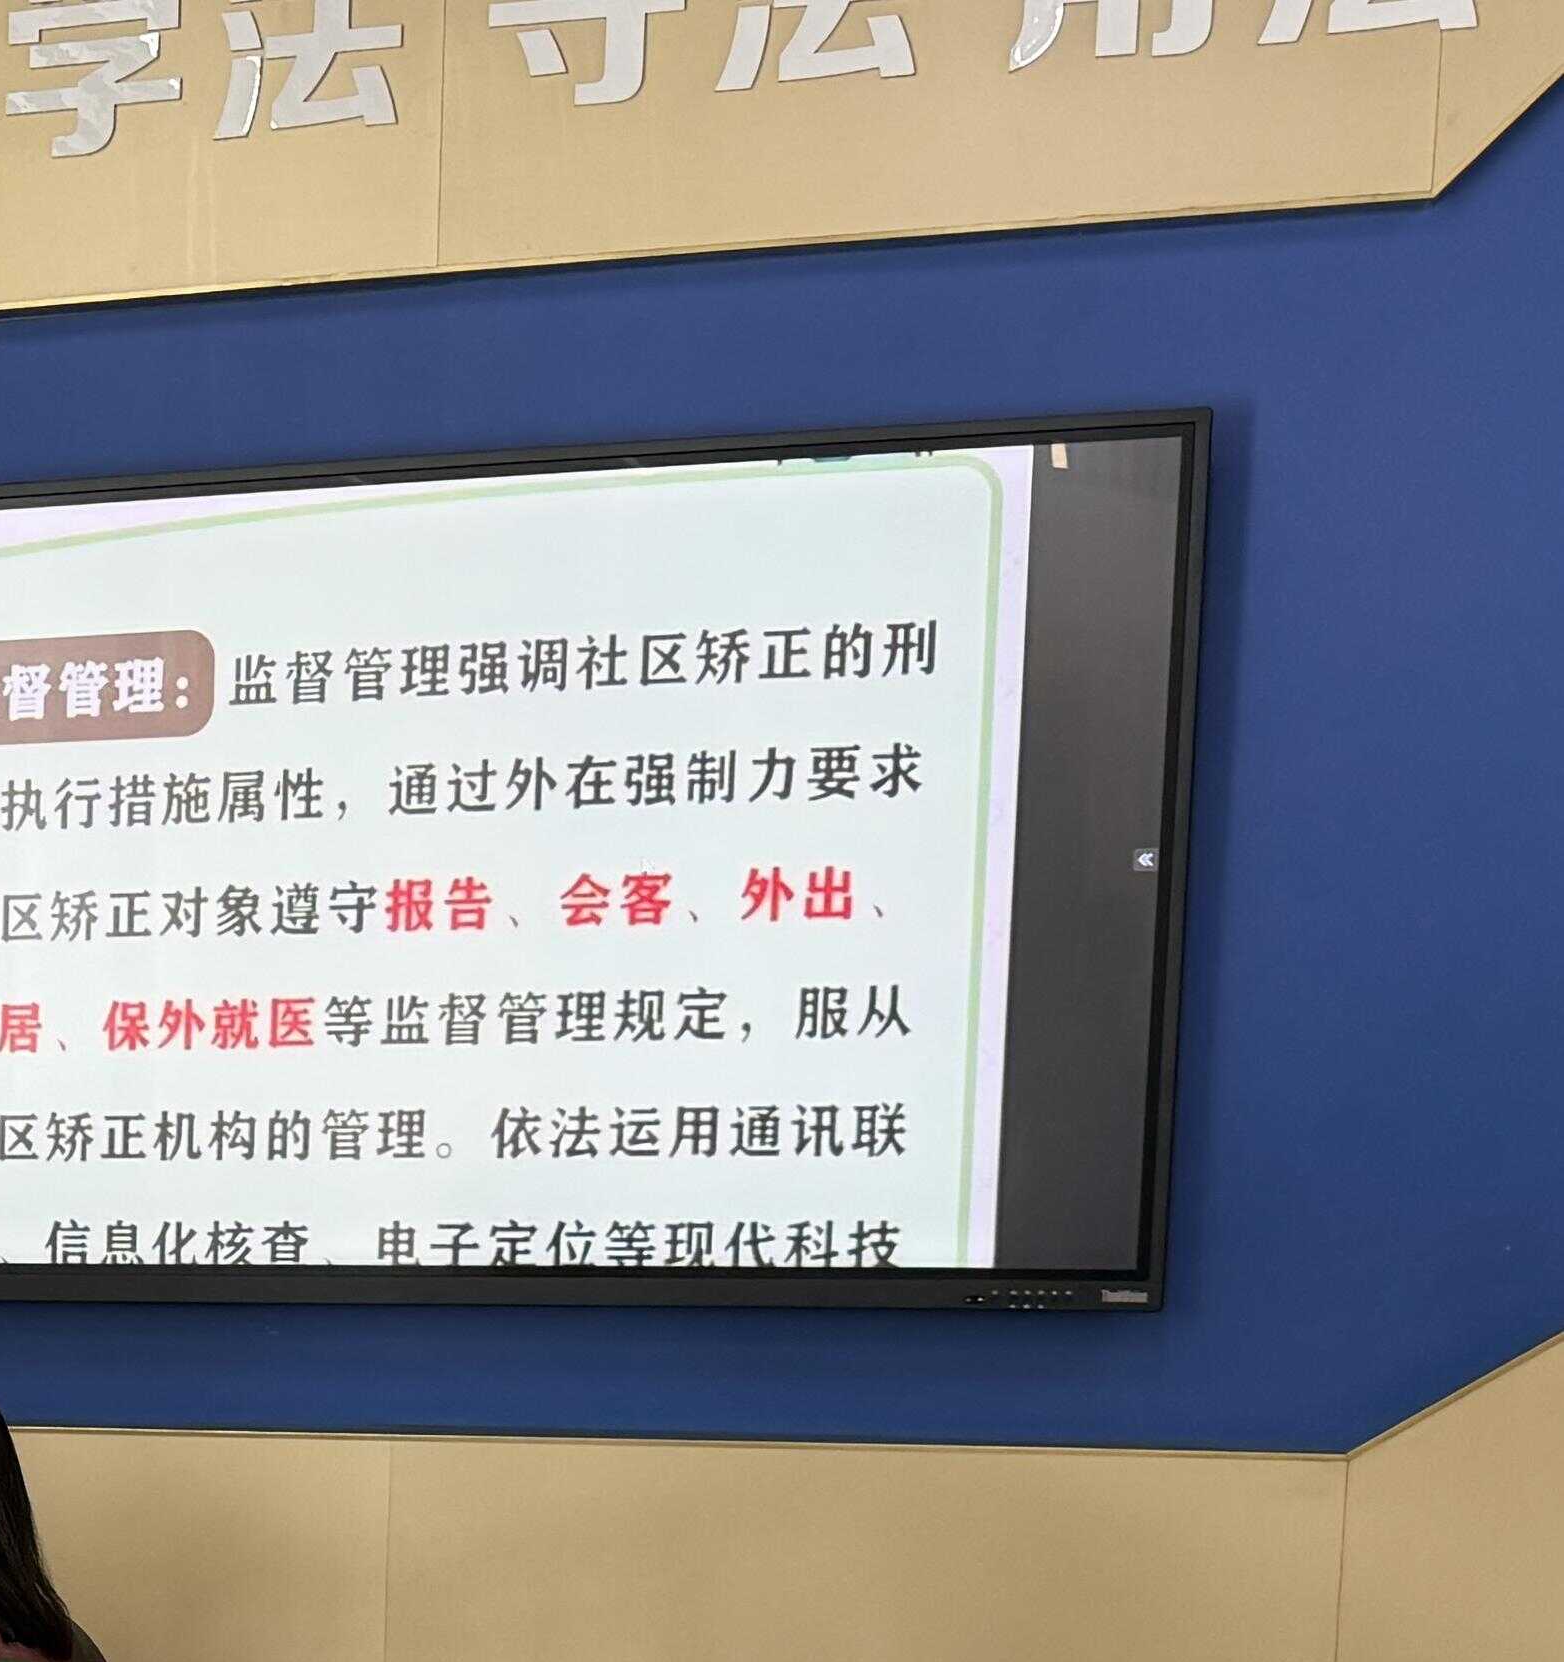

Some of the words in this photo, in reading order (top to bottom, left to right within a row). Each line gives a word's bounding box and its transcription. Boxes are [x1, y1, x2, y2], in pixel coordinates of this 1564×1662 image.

[228, 620, 940, 708] 监督管理强调社区矫正的刑
